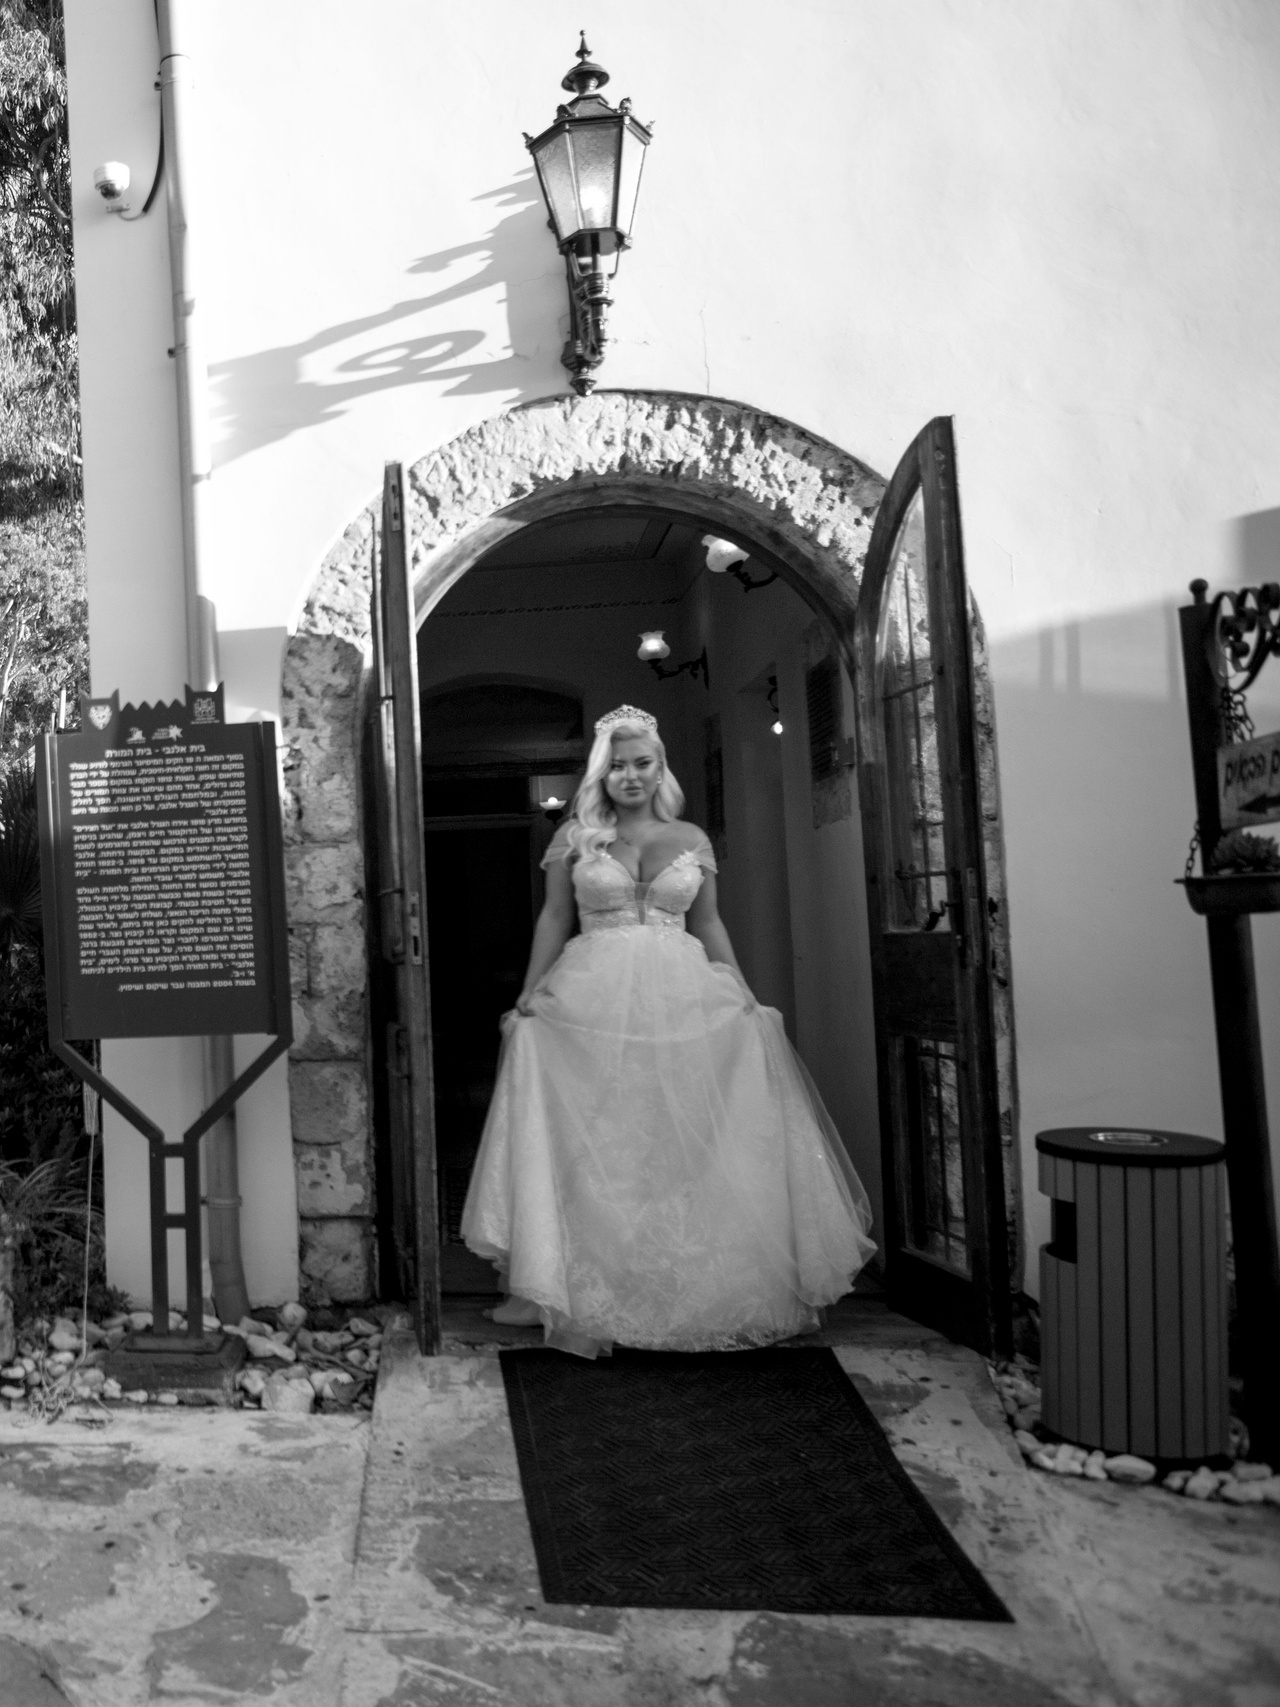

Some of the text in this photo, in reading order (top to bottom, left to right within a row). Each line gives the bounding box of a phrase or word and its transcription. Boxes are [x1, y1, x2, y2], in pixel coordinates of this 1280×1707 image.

[104, 744, 205, 758] בית אלנבי בית המורה
